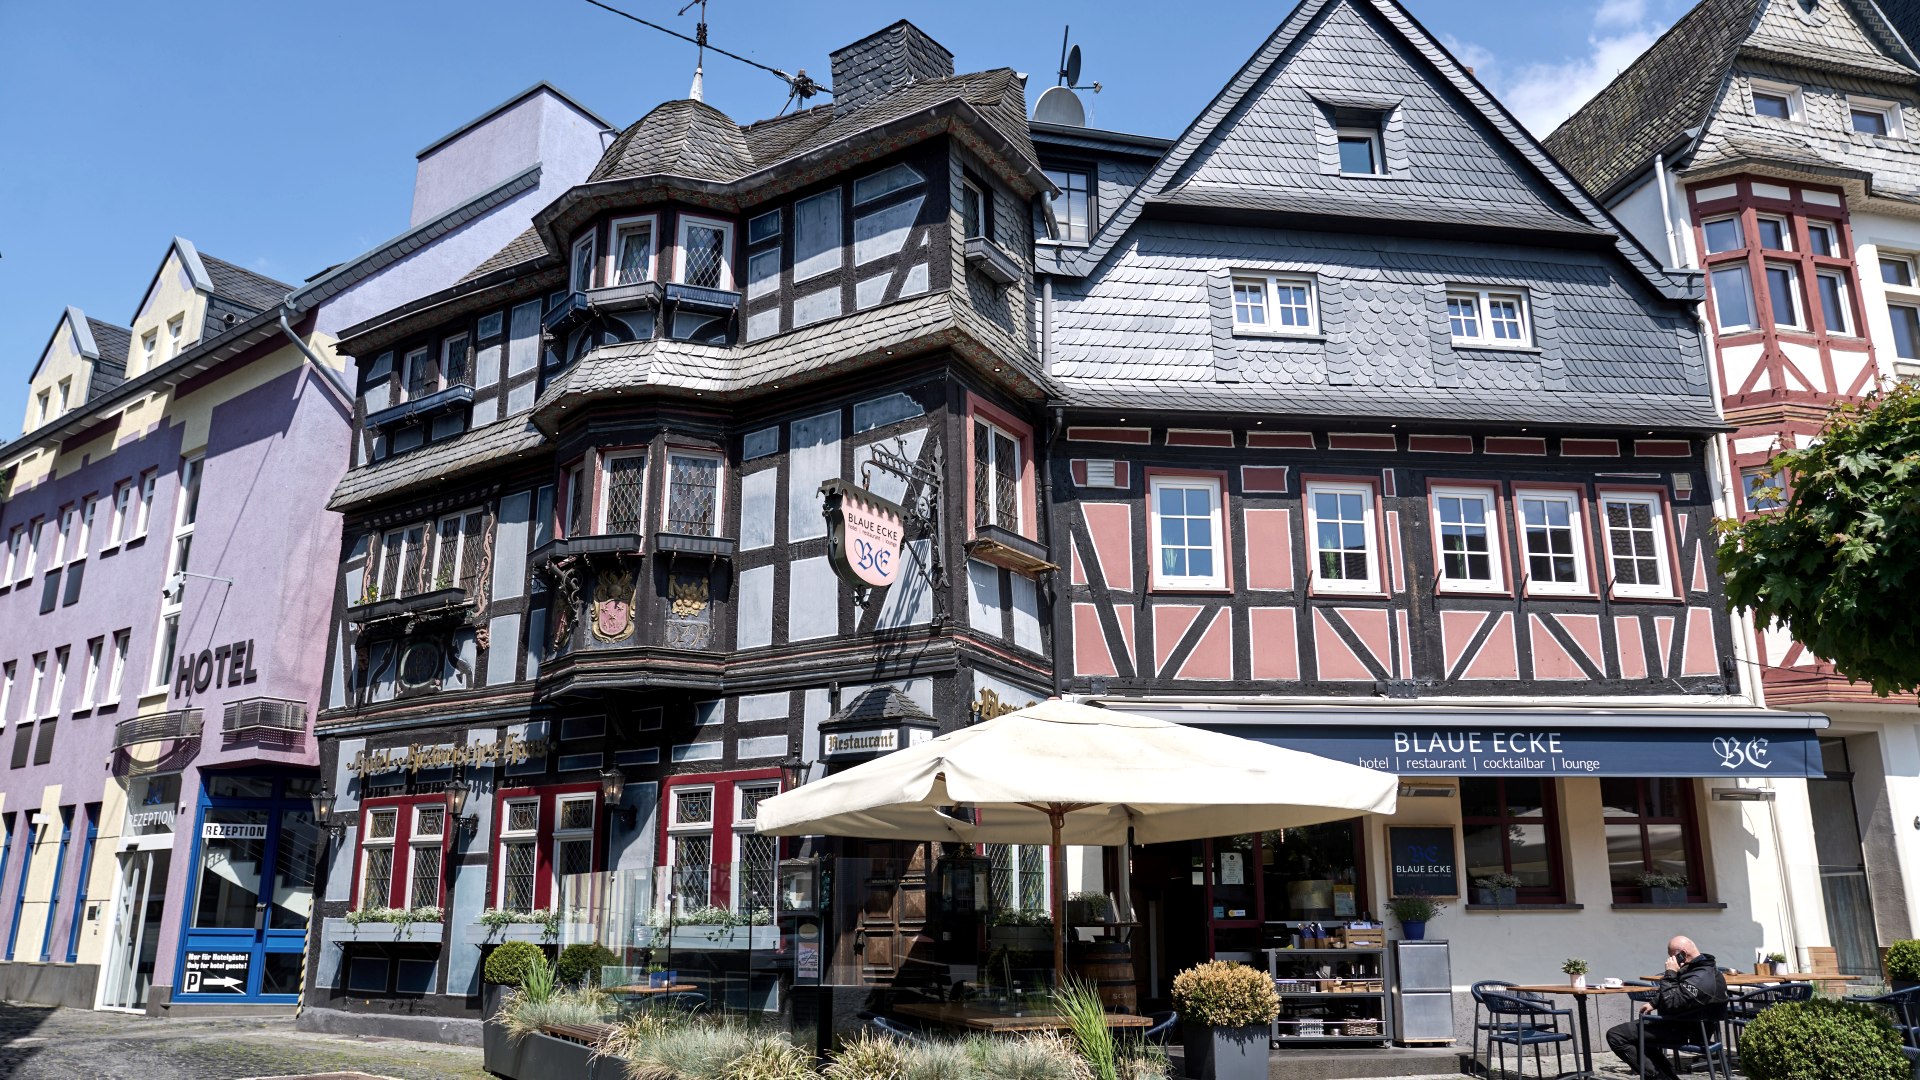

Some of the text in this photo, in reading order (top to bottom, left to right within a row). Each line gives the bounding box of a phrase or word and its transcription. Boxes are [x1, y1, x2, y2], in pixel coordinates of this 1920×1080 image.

[848, 512, 898, 541] BLAUE ECKE
[854, 538, 891, 577] BE
[175, 638, 258, 700] HOTEL
[828, 732, 895, 751] Restaurant
[1394, 731, 1563, 753] BLAUE ECKE
[1712, 736, 1772, 769] BE
[1359, 756, 1600, 772] hotel restaurant cocktailbar lounge
[128, 809, 175, 828] REZEPTION
[205, 824, 265, 837] REZEPTION
[1396, 865, 1452, 873] BLAUE ECKE
[187, 962, 200, 970] Only
[188, 953, 201, 961] Nur
[202, 953, 212, 961] für
[186, 973, 198, 989] P
